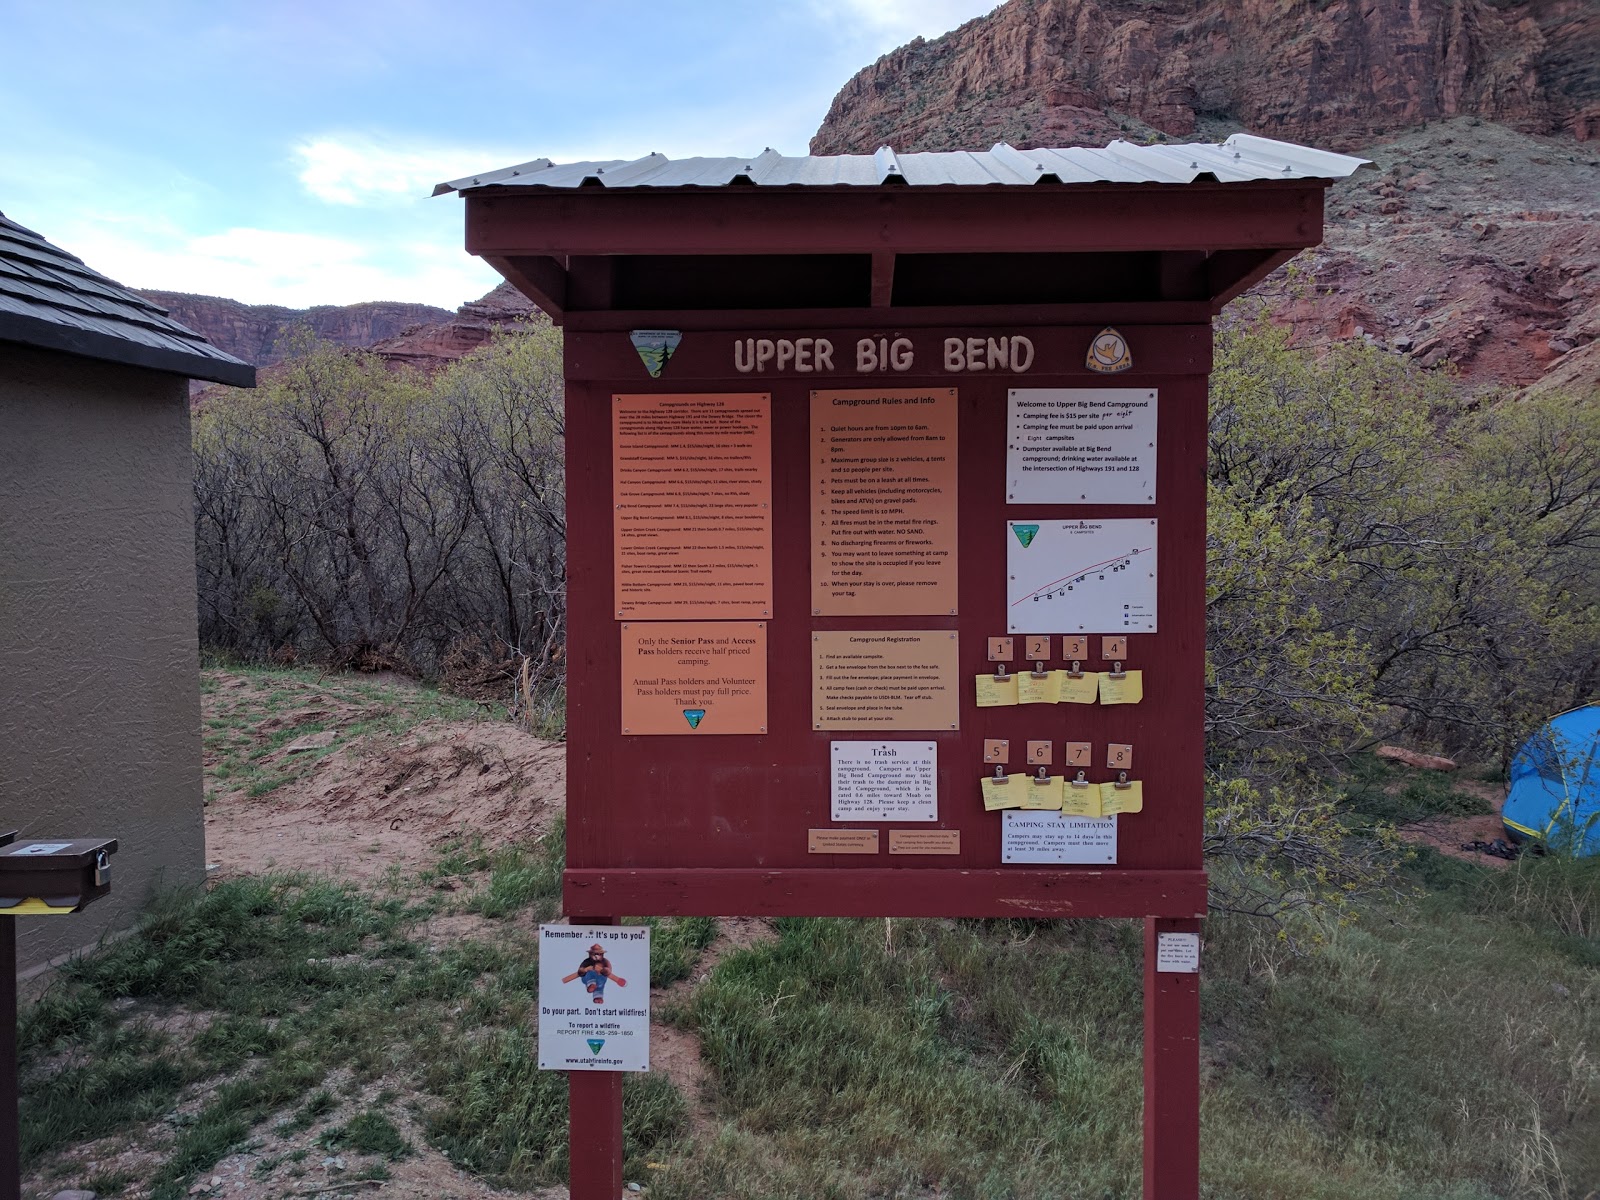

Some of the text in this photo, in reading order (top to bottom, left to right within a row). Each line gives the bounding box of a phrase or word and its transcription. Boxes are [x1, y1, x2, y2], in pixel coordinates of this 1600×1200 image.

[735, 336, 1034, 372] UPPER BIG BEND
[832, 398, 880, 407] Campground
[882, 397, 902, 405] Rules
[638, 638, 656, 646] Only
[728, 647, 750, 656] priced
[997, 644, 1003, 653] 1
[1035, 643, 1041, 652] 2
[1072, 644, 1079, 652] 3
[1111, 644, 1117, 652] 4
[678, 658, 710, 666] camping.
[731, 688, 751, 696] price.
[994, 747, 1000, 756] 5
[1036, 748, 1043, 757] 6
[1076, 750, 1082, 759] 7
[1117, 752, 1123, 761] 8
[545, 930, 583, 938] Remember
[596, 931, 607, 939] It's
[630, 932, 646, 940] you.
[567, 1008, 581, 1016] part.
